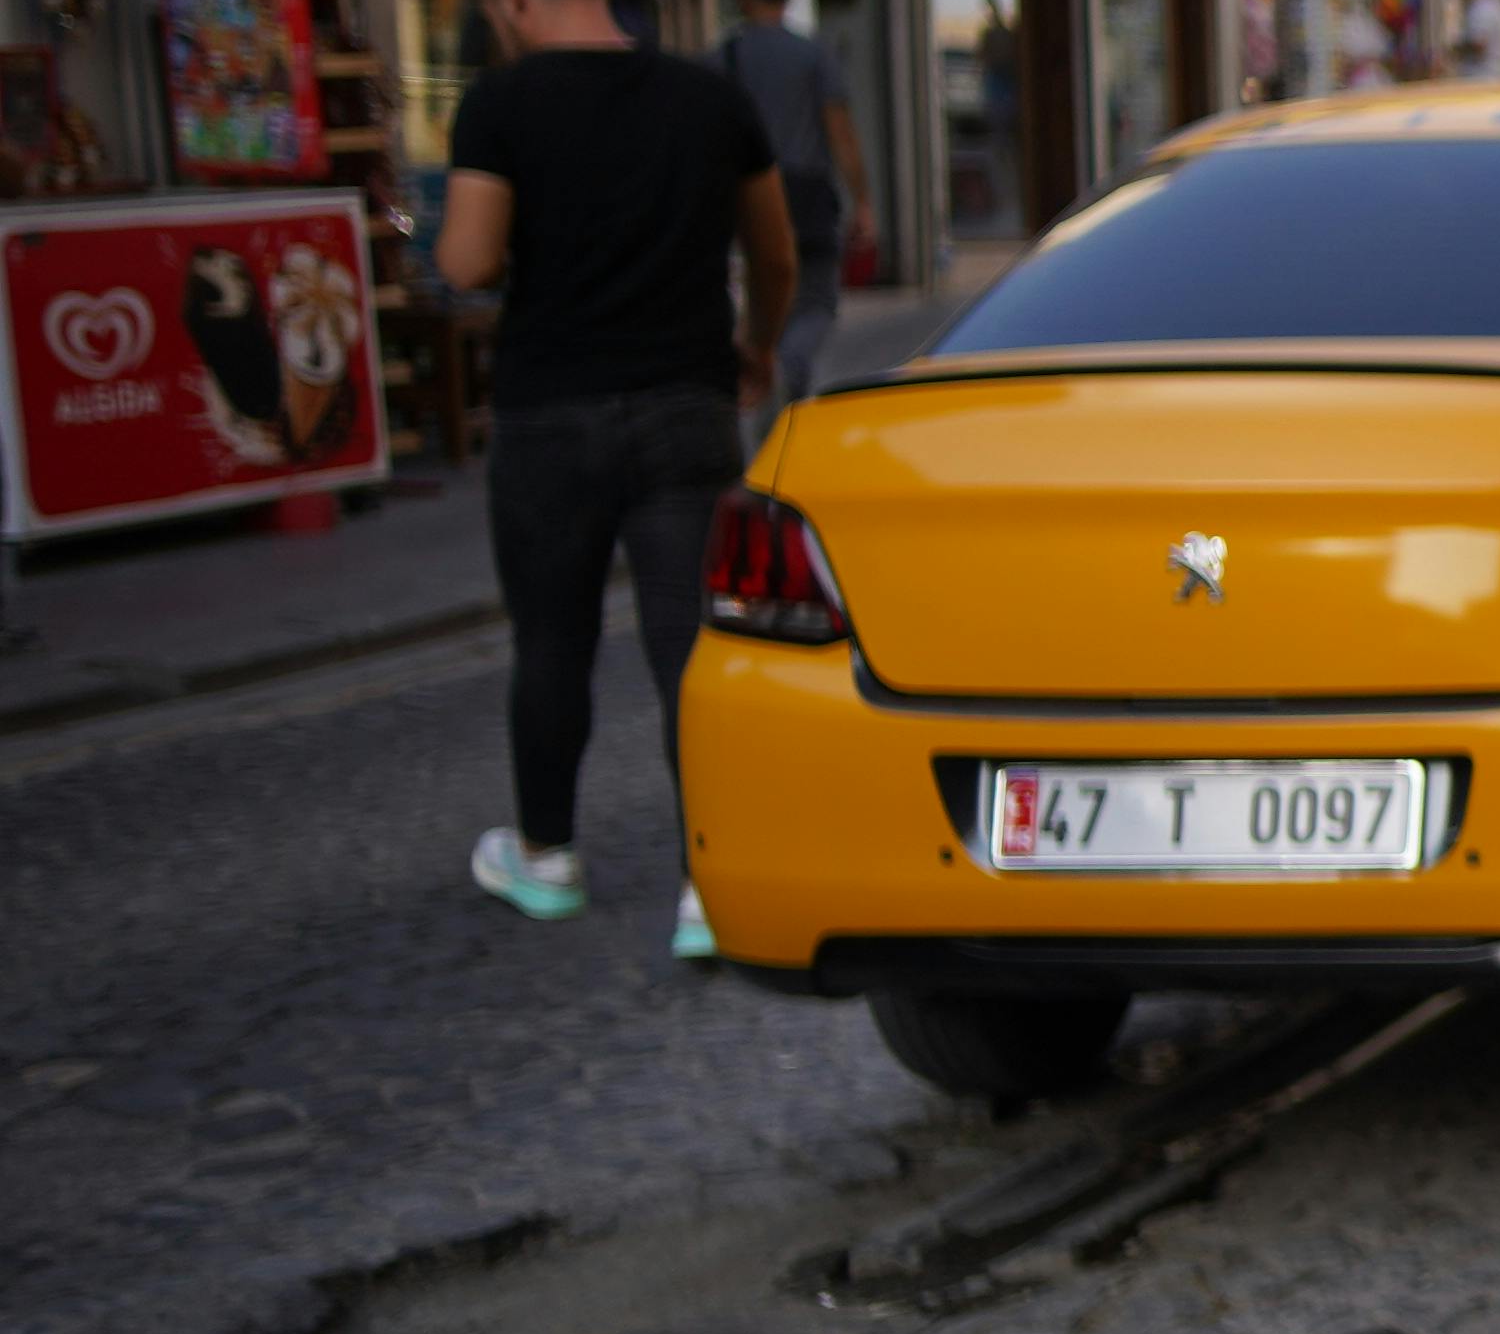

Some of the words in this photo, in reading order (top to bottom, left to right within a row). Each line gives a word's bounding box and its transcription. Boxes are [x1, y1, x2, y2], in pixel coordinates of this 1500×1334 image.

[1038, 781, 1109, 847] 47
[1164, 781, 1196, 846] T
[1248, 781, 1396, 846] 0097
